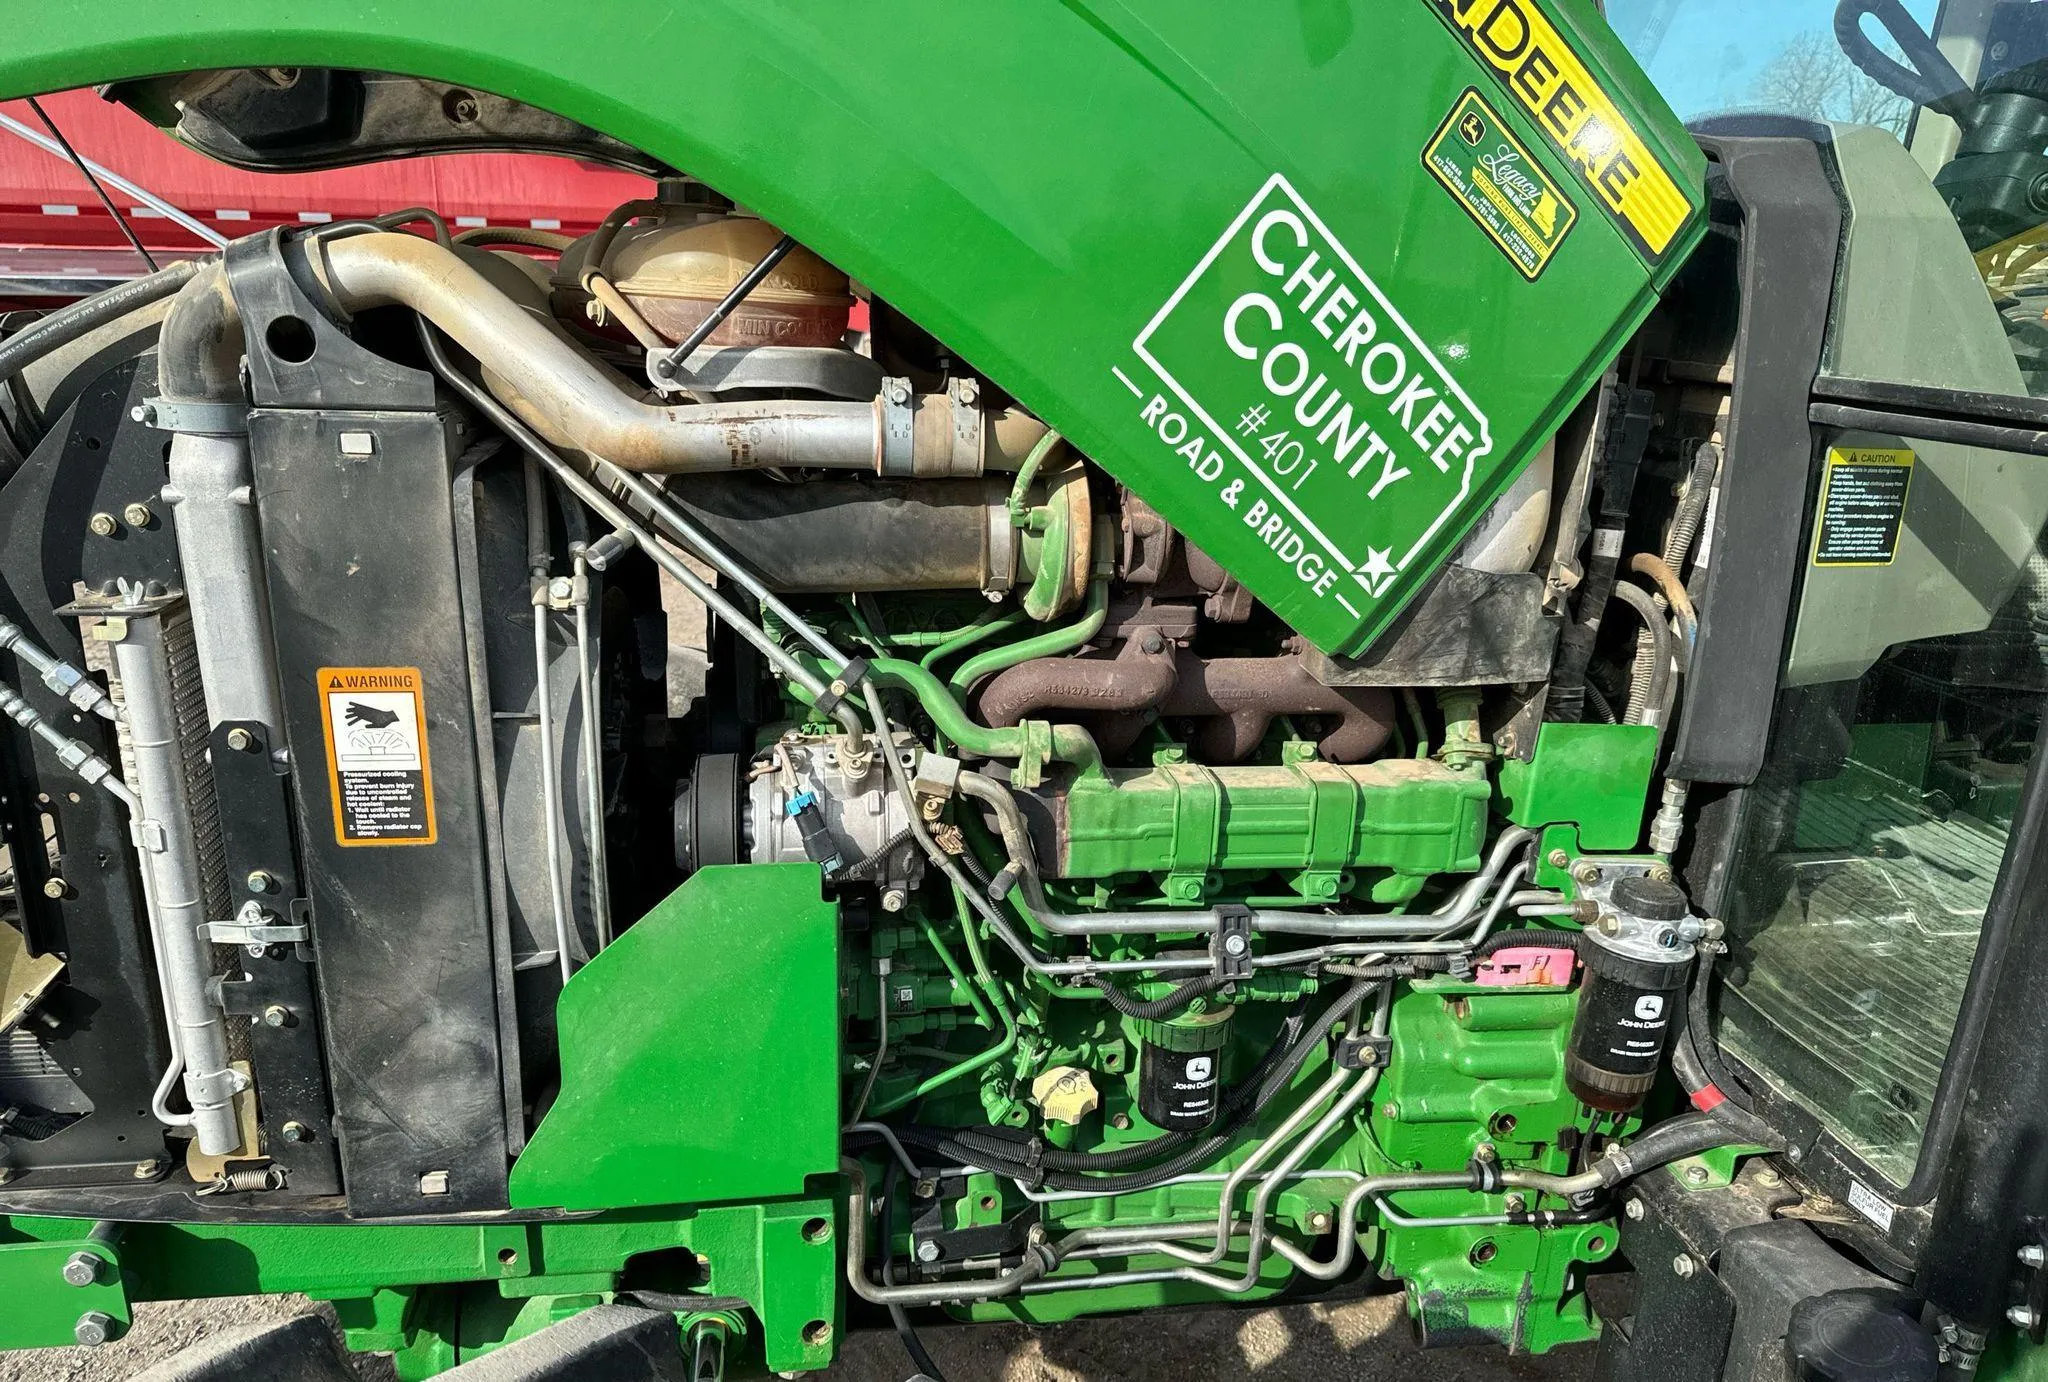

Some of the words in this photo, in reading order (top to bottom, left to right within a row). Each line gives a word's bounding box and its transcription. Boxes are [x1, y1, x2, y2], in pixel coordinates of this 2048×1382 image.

[1483, 144, 1542, 201] Legacy
[1475, 174, 1499, 200] NOTHING
[1511, 214, 1527, 231] LIKE
[1480, 196, 1498, 216] JOPLIN
[1510, 230, 1535, 260] LOCKWOOD
[98, 283, 150, 309] GOODYEAR
[738, 318, 770, 336] MIN
[1251, 209, 1474, 474] CHEROKEE
[1223, 292, 1411, 500] COUNTY
[1236, 402, 1318, 491] #401
[1860, 454, 1896, 463] CAUTION
[1140, 394, 1224, 482] ROAD
[1220, 478, 1246, 510] &
[1243, 498, 1337, 598] BRIDGE
[346, 676, 412, 688] WARNING
[1617, 1018, 1643, 1028] JOHN
[1644, 1020, 1666, 1028] DEERE
[1850, 1196, 1865, 1210] ONLY
[1852, 1184, 1872, 1200] ULTRA
[1872, 1199, 1886, 1212] LOW
[1875, 1207, 1889, 1222] FUEL
